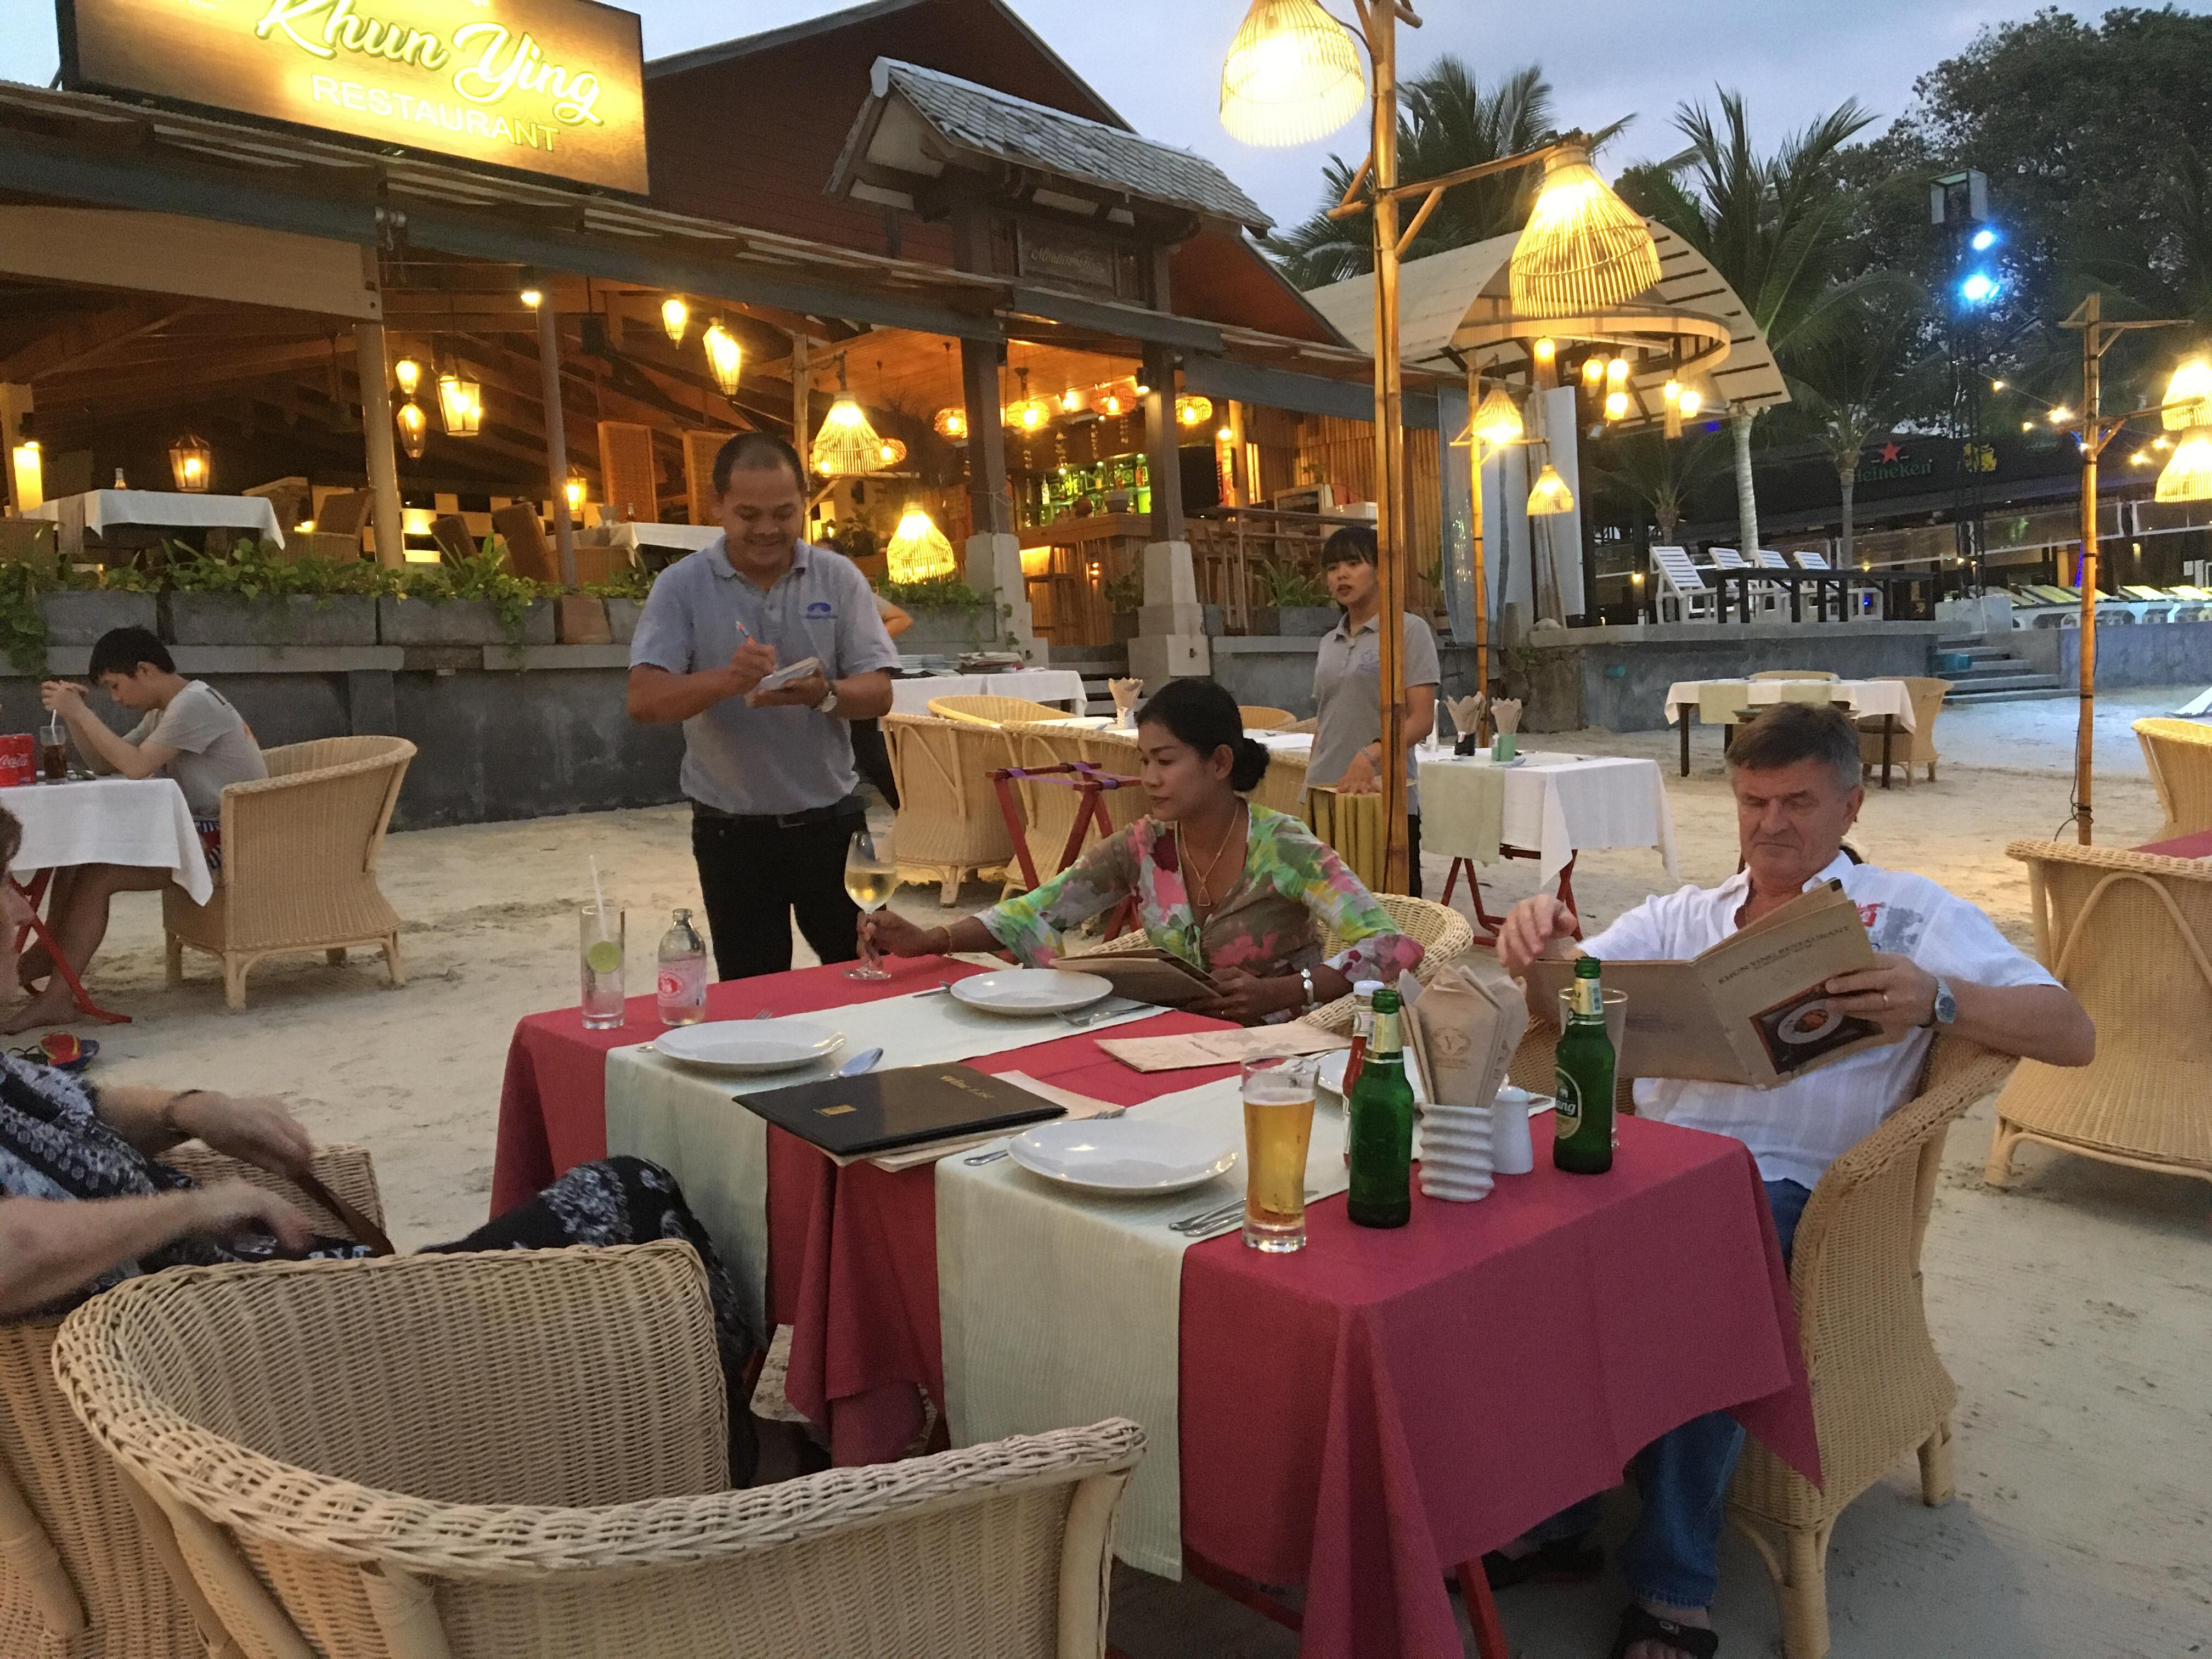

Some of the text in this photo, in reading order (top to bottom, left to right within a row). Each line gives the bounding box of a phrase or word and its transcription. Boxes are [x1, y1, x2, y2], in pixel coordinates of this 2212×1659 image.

[254, 0, 605, 127] Khun Ying
[311, 73, 560, 153] RESTAURANT
[1778, 926, 1850, 954] RESTAURANT
